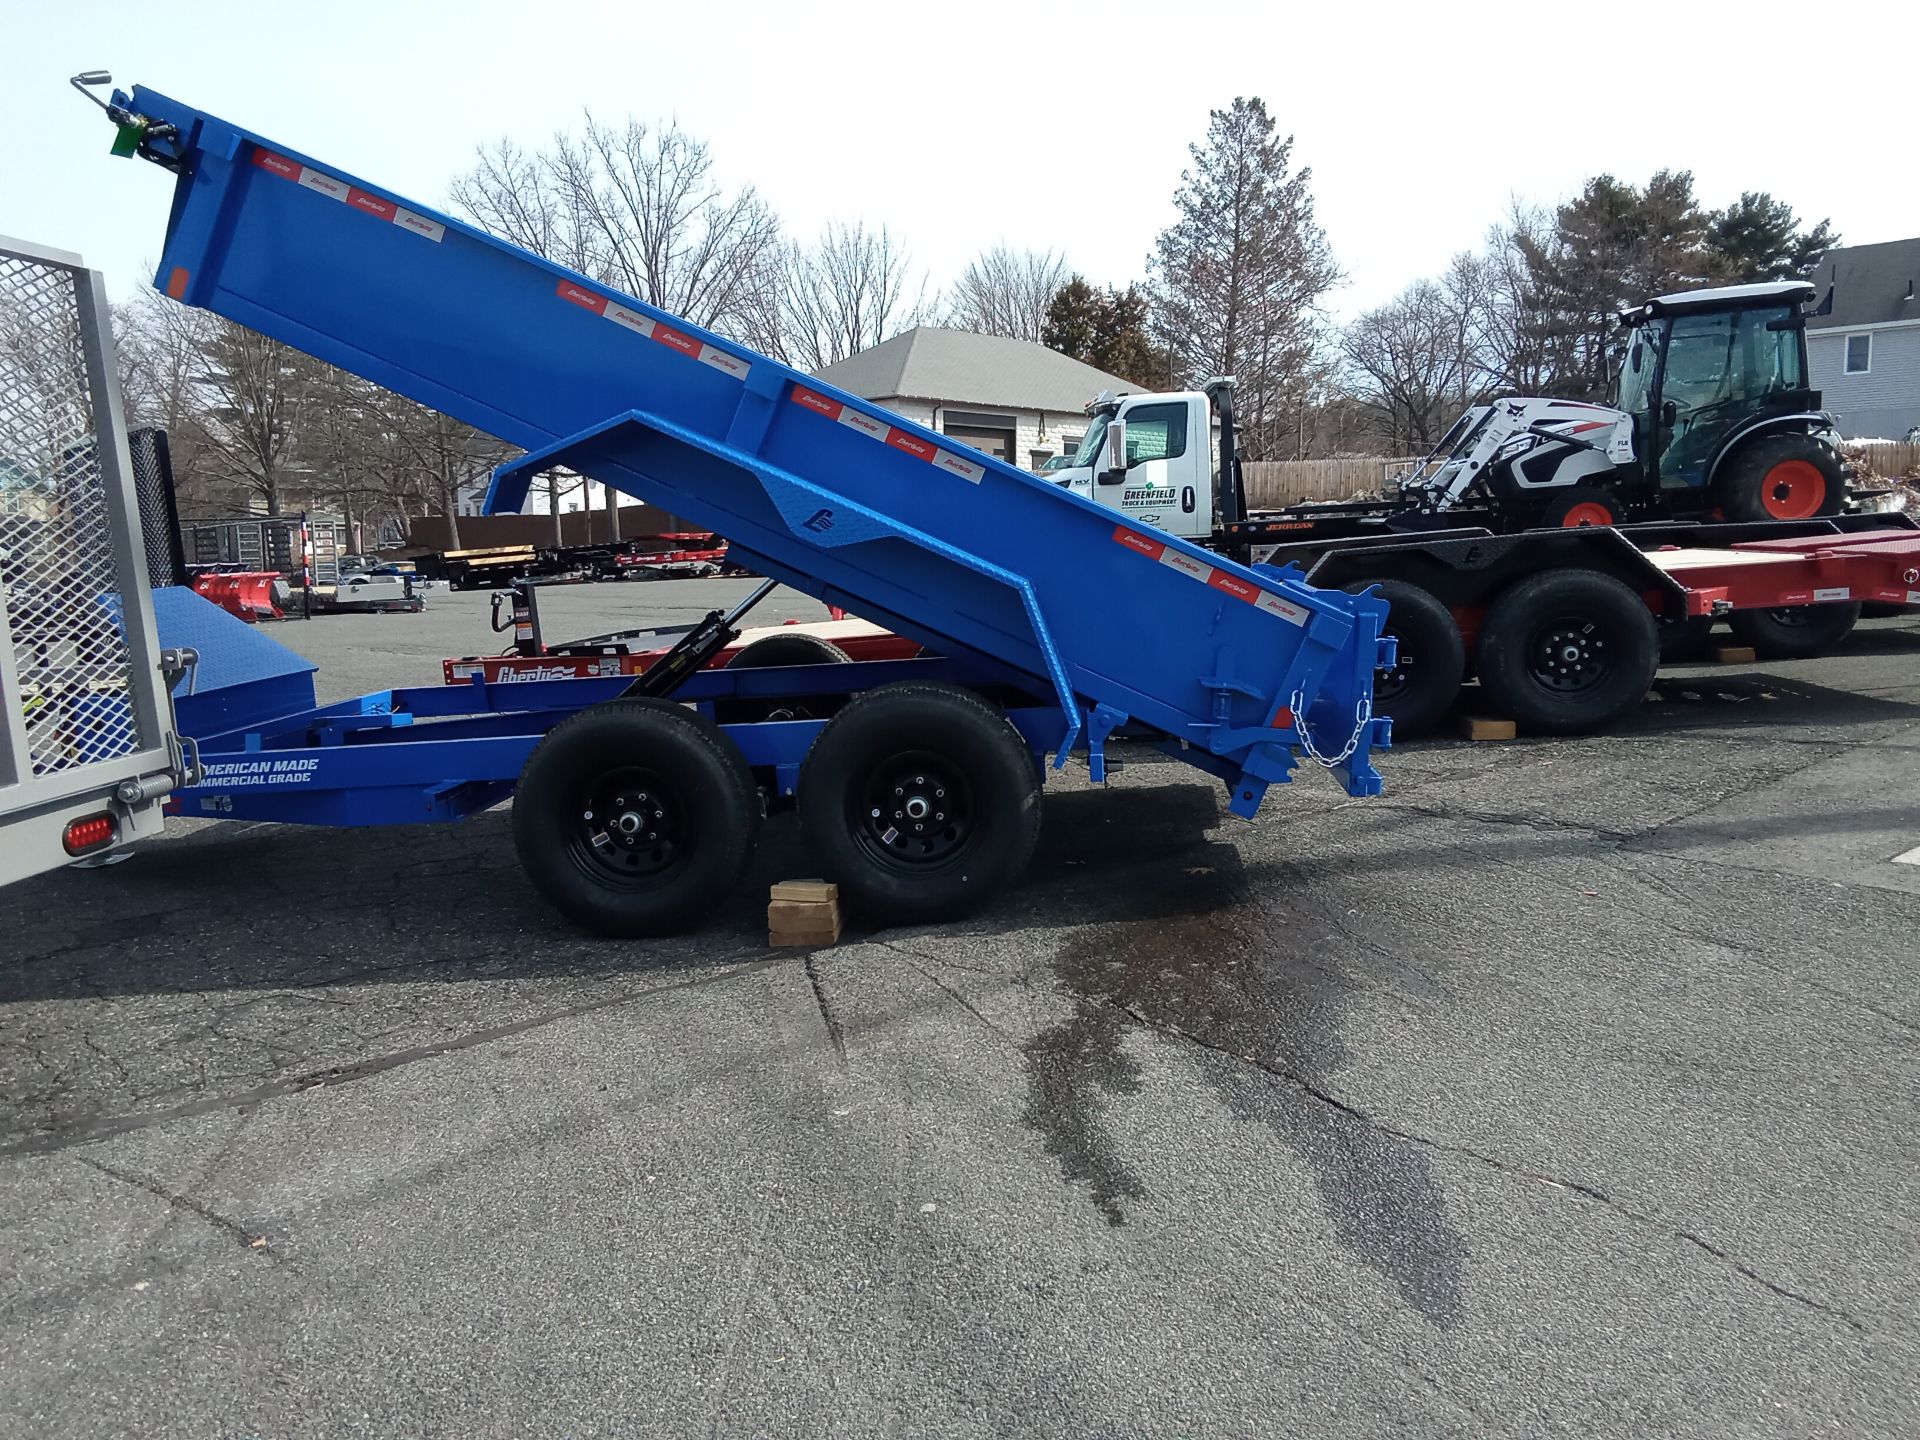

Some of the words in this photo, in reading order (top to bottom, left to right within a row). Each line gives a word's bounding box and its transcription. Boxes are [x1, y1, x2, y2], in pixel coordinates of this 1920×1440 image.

[1124, 489, 1176, 500] GREENFIELD
[204, 761, 271, 776] MERICAN
[273, 759, 319, 772] MADE
[200, 775, 266, 788] MMERCIAL
[268, 772, 311, 784] GRADE
